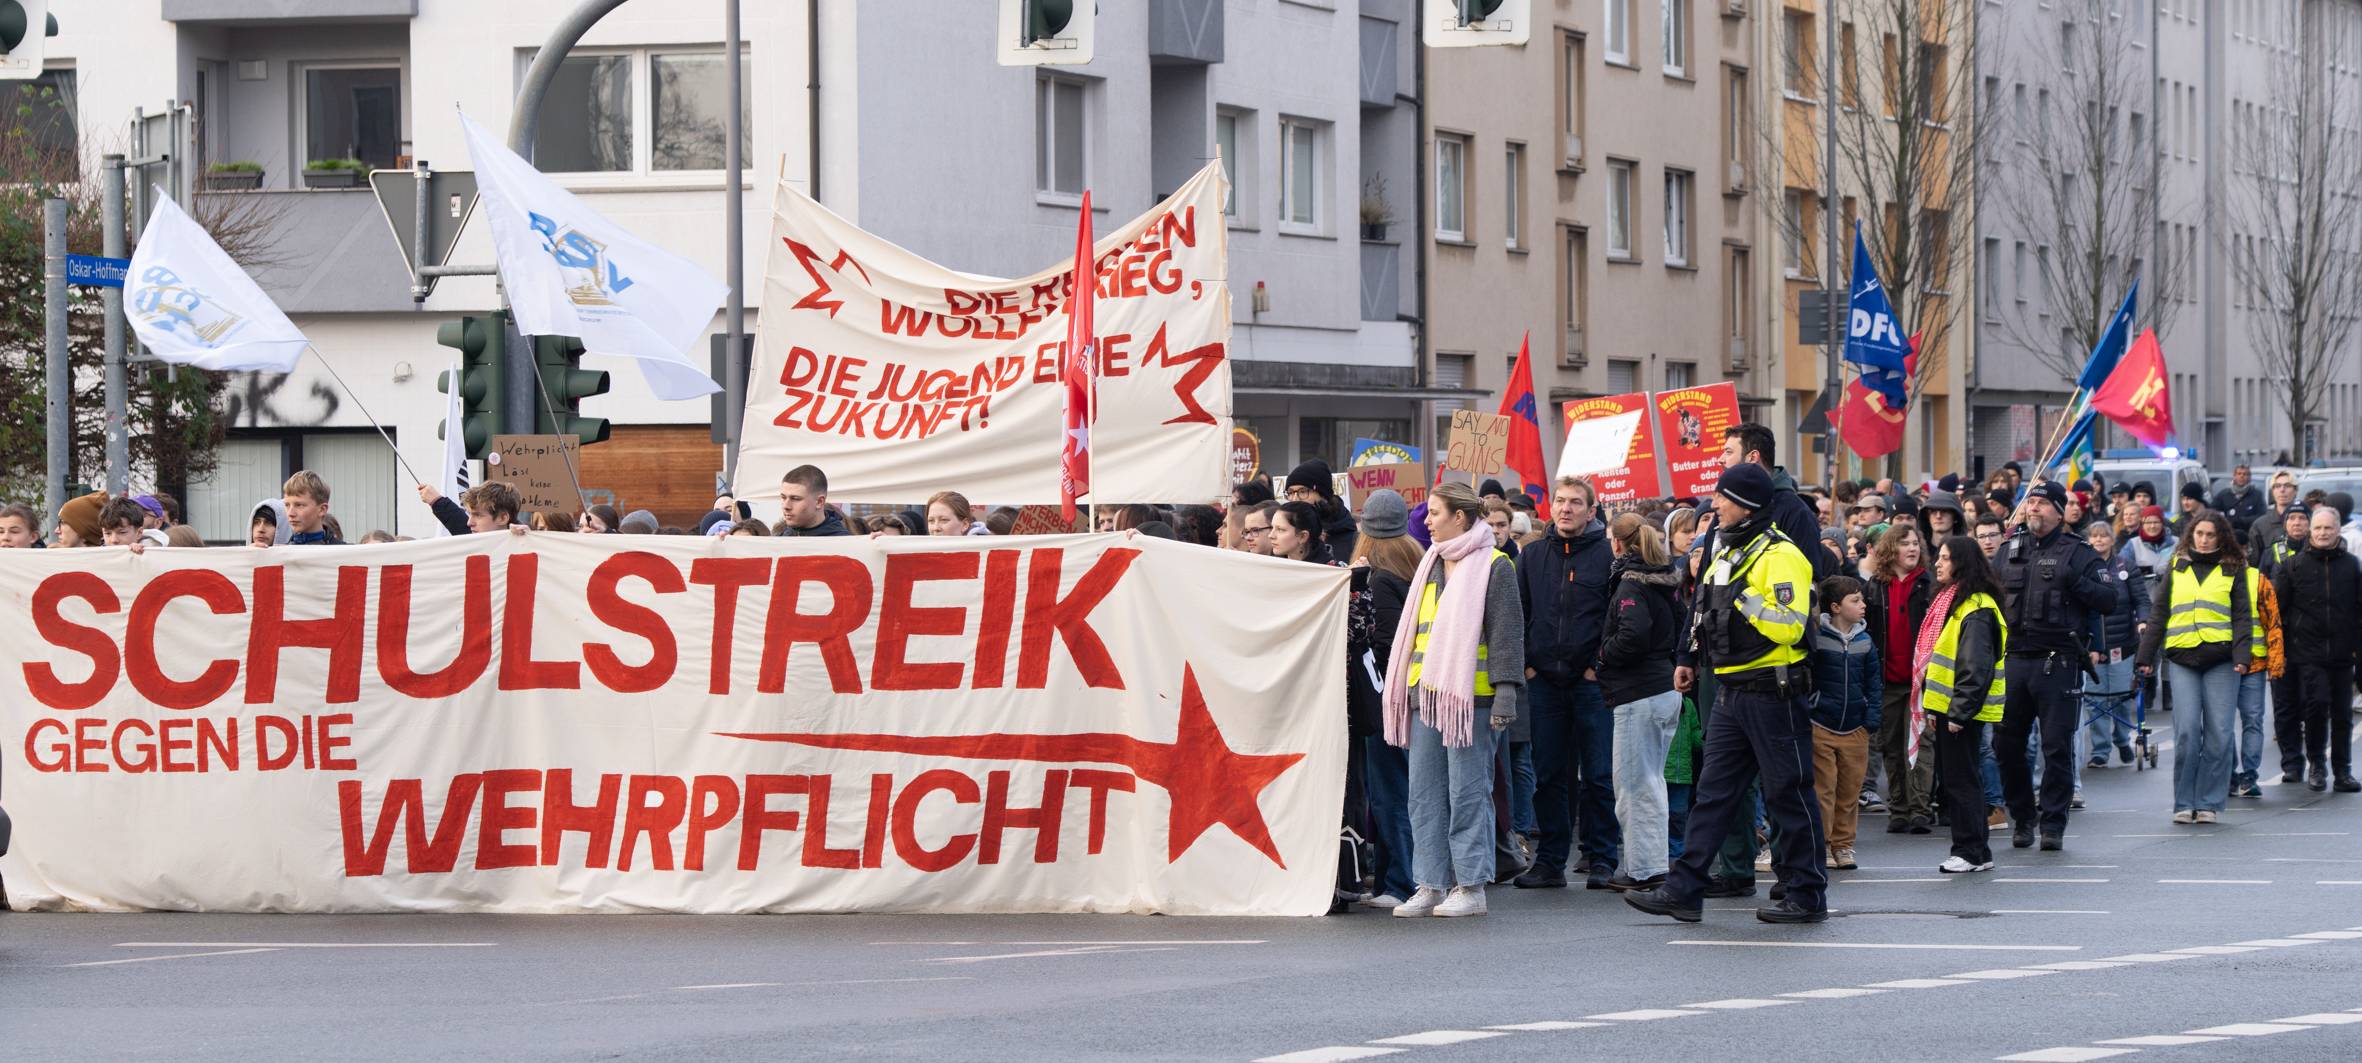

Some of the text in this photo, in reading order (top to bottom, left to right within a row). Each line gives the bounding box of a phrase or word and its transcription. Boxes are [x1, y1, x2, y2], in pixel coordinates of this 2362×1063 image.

[944, 288, 1020, 316] DIE
[779, 346, 868, 398] DIE
[867, 355, 1026, 403] JUGEND
[1567, 400, 1623, 420] WIDERSTAND
[1659, 391, 1713, 411] WIDERSTAND
[773, 388, 990, 440] ZUKUNFT!
[1453, 411, 1510, 437] SAY NO
[1471, 432, 1488, 447] TO
[1447, 441, 1505, 475] GUNS
[1672, 461, 1700, 472] Butter
[1349, 469, 1396, 490] WENN
[1605, 479, 1626, 490] oder
[1701, 470, 1720, 481] oder
[1598, 489, 1636, 502] Panzer?
[22, 548, 1142, 710] SCHULSTREIK
[25, 713, 357, 773] GEGEN DIE
[338, 768, 1136, 877] WEHRPFLICHT
